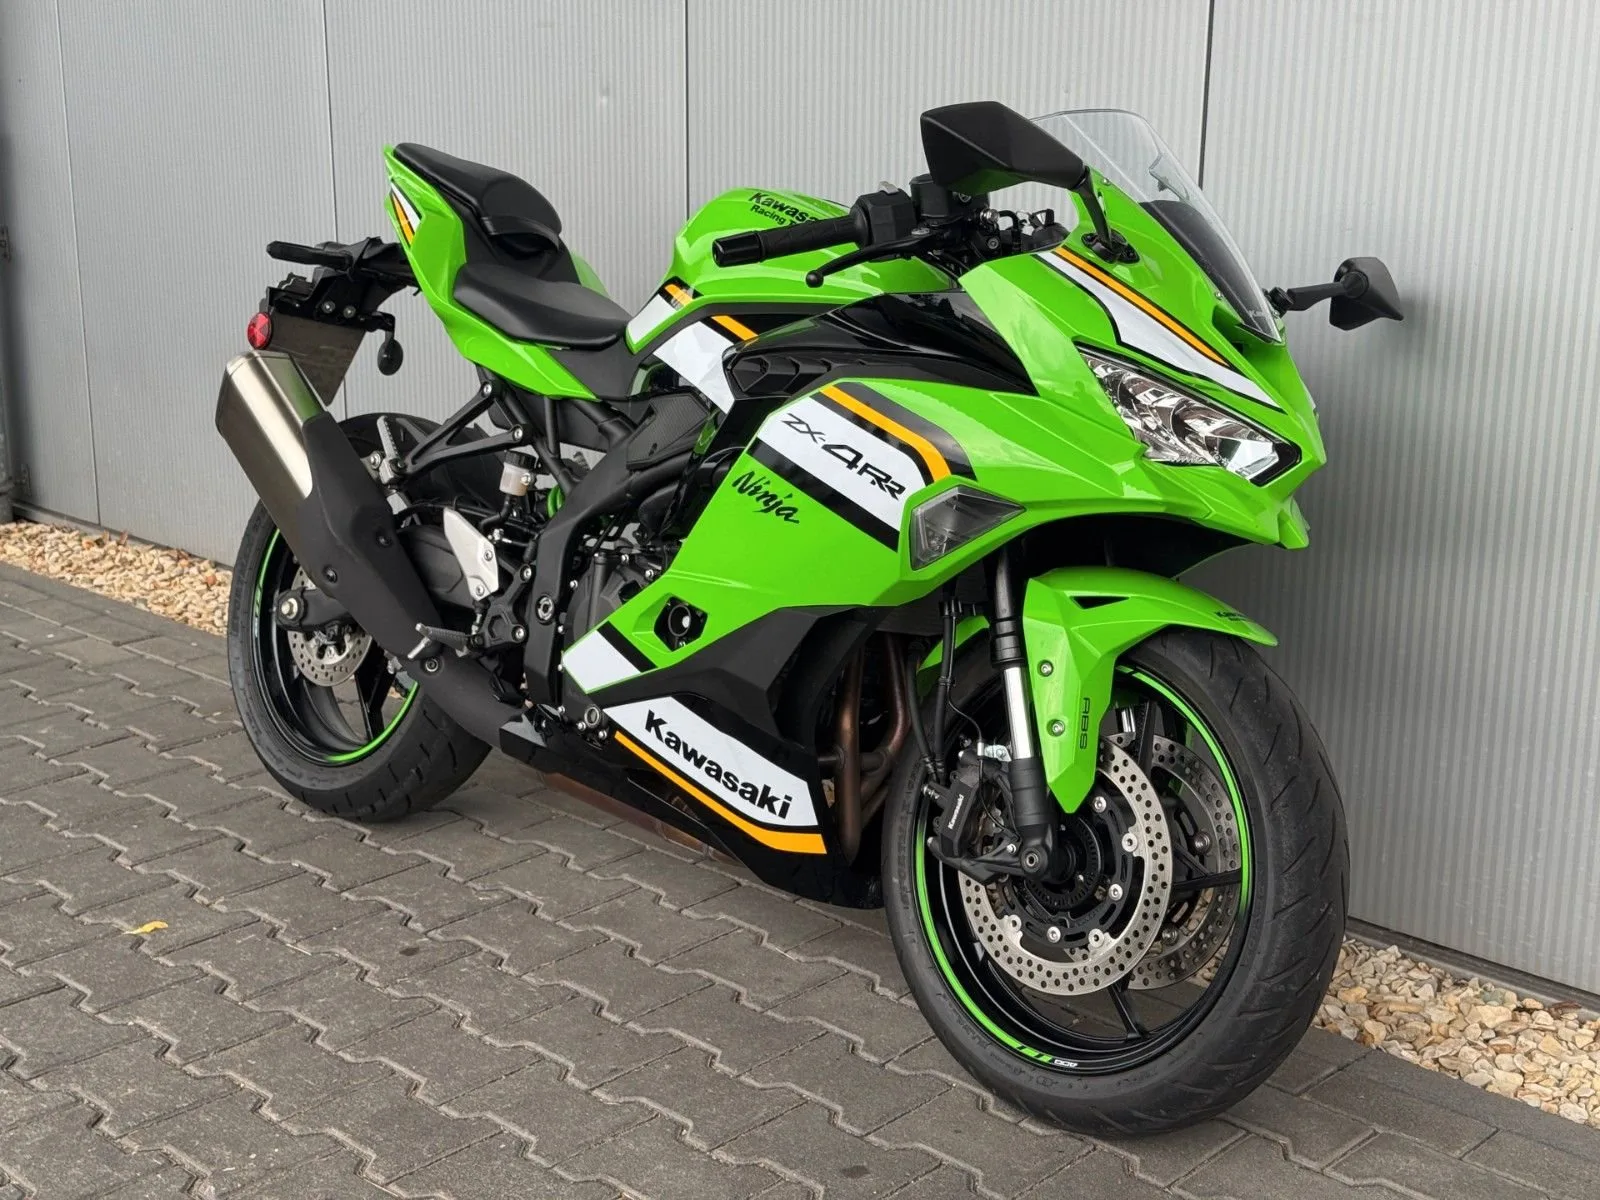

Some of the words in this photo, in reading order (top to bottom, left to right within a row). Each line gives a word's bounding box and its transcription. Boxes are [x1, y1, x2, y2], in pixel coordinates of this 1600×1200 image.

[750, 204, 787, 226] Racing
[781, 413, 906, 501] ZX-4RR
[731, 471, 800, 524] Ninja
[1079, 697, 1091, 750] ABS
[644, 709, 793, 820] Kawasaki
